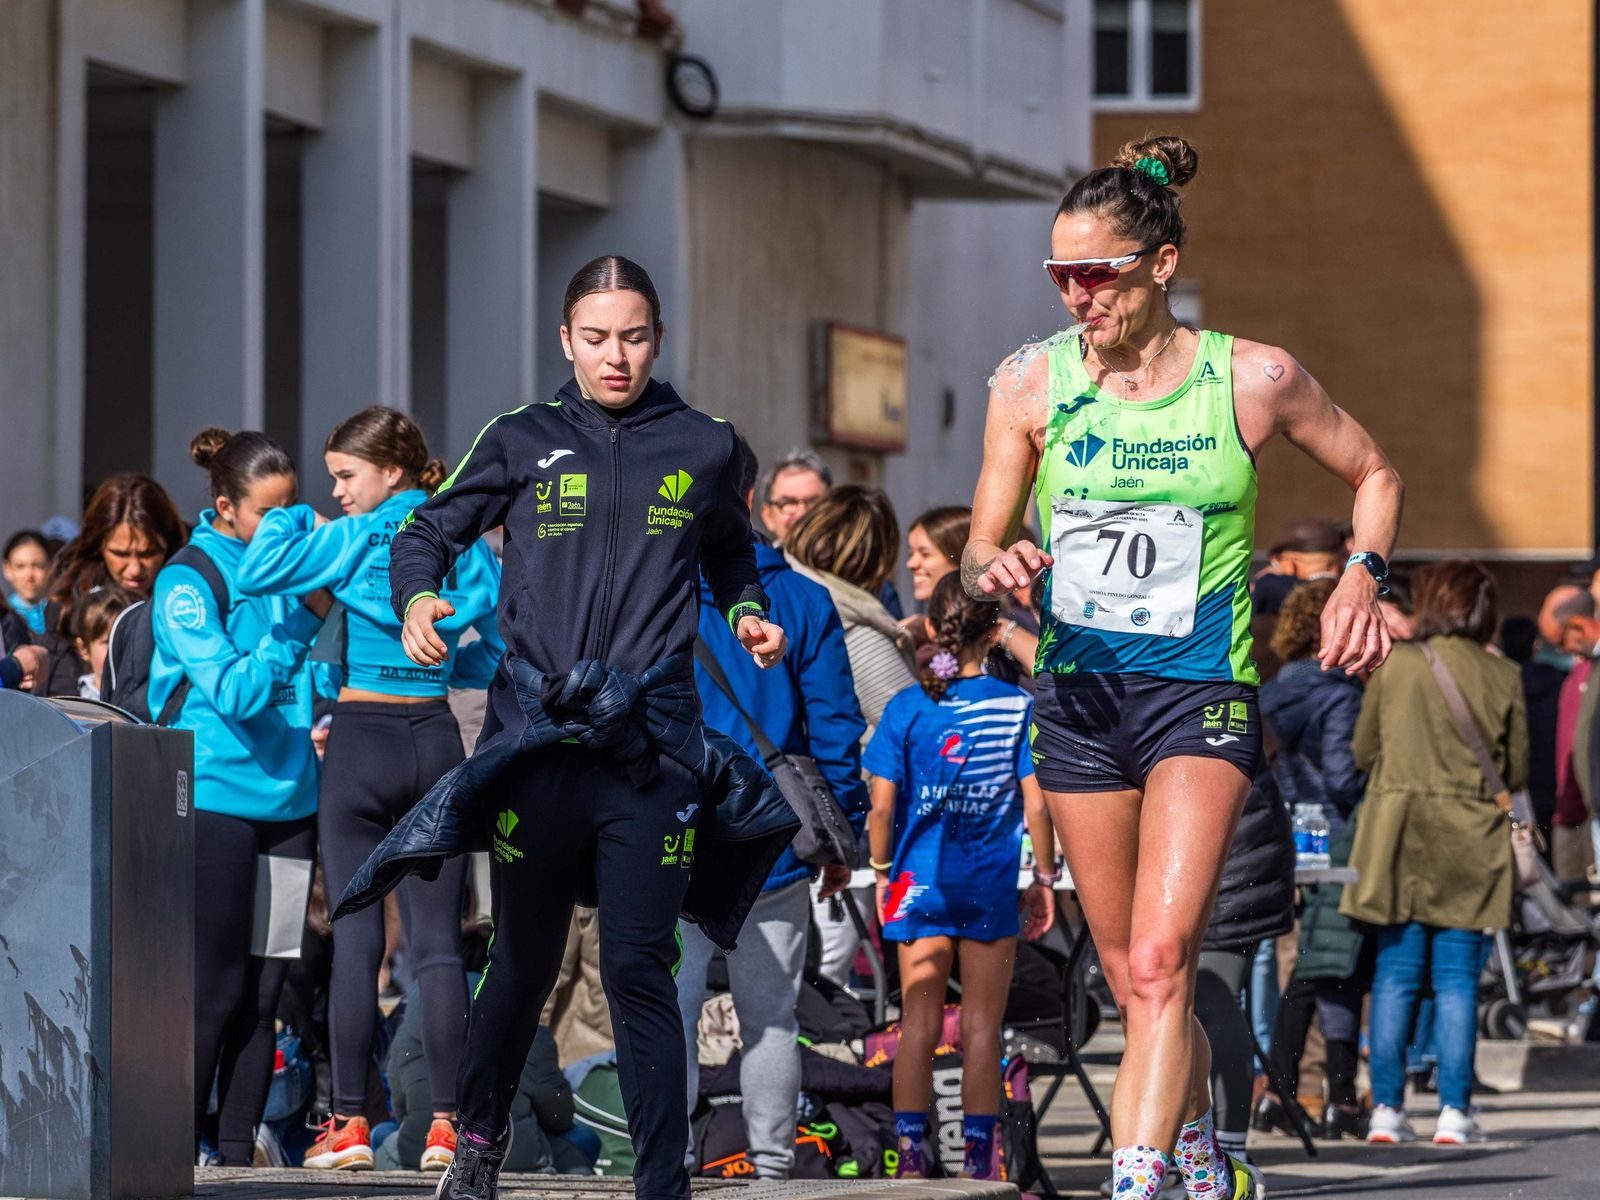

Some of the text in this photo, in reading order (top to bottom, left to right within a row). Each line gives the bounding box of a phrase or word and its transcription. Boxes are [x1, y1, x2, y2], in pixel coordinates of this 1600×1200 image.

[1112, 433, 1217, 454] Fundación
[1112, 454, 1189, 474] Unicaja
[1110, 476, 1144, 489] Jaén
[648, 505, 694, 521] Fundación
[647, 515, 683, 529] Unicaja
[645, 527, 663, 535] Jaén
[1096, 529, 1157, 579] 70
[1203, 719, 1223, 729] jaén
[661, 854, 678, 865] jaén
